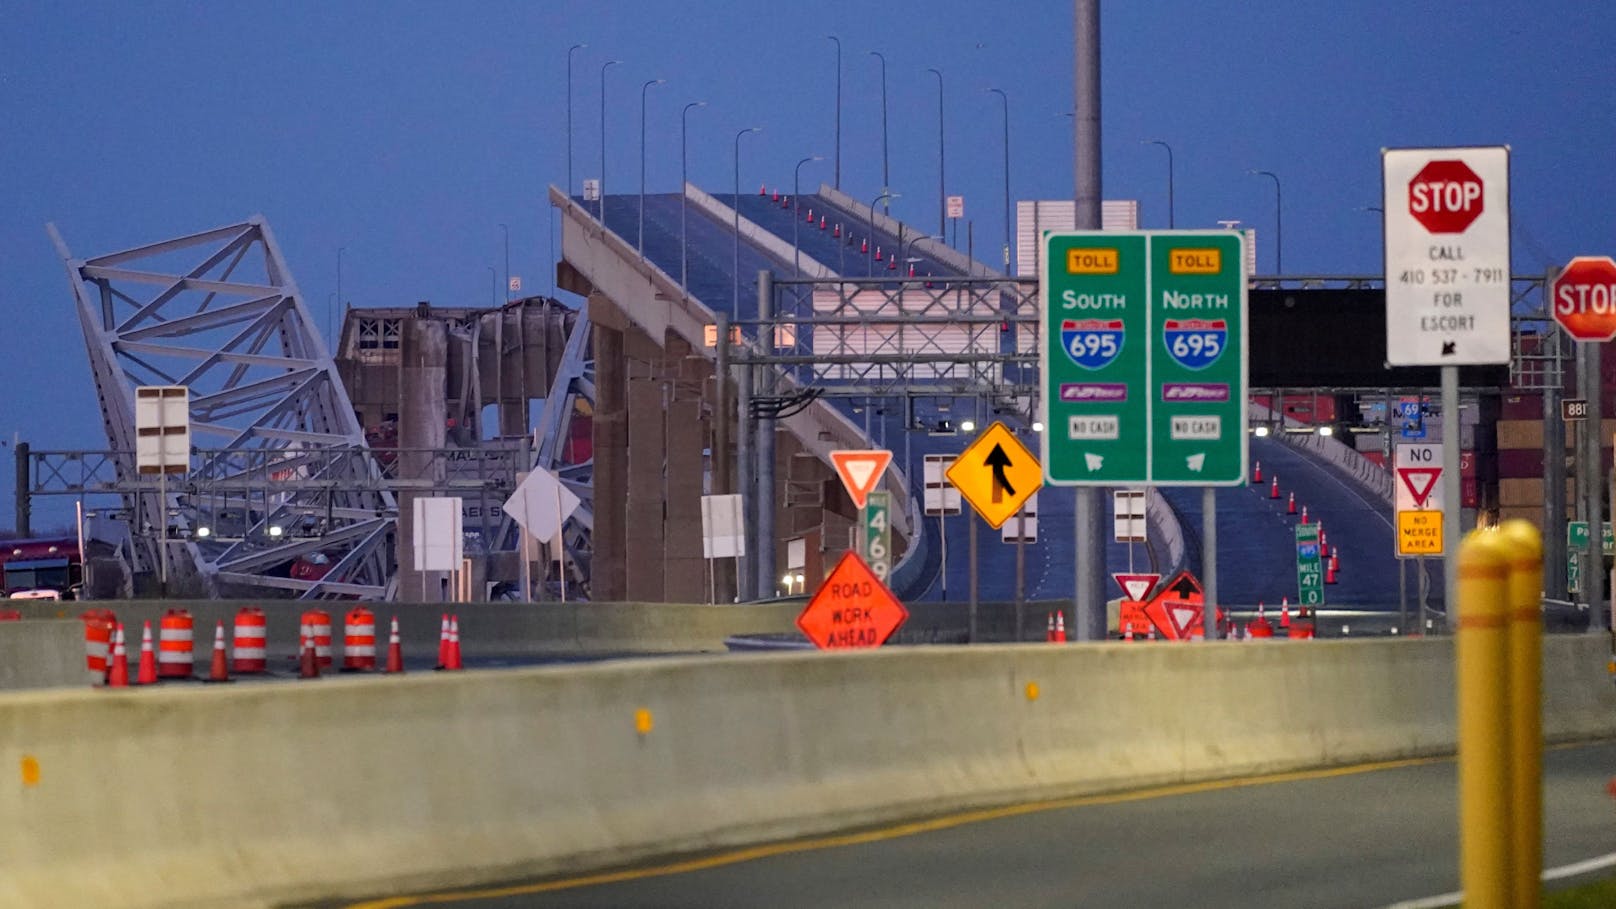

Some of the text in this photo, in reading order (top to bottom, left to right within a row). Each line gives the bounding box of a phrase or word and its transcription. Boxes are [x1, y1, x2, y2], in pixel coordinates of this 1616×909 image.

[1412, 181, 1480, 213] STOP
[1429, 246, 1465, 260] CALL
[1074, 255, 1112, 267] TOLL
[1176, 255, 1214, 267] TOLL
[1399, 270, 1425, 284] 410
[1431, 269, 1458, 283] 537
[1473, 268, 1503, 283] 7911
[1434, 293, 1462, 307] FOR
[1421, 315, 1475, 331] ESCORT
[1070, 334, 1117, 357] 695
[1173, 334, 1220, 357] 695
[1074, 421, 1115, 432] NO CASH
[1175, 421, 1217, 432] NO CASH
[1410, 449, 1432, 462] NO
[1404, 528, 1437, 537] MERGE
[1407, 540, 1435, 548] AREA
[1300, 562, 1319, 573] MILE
[1302, 574, 1318, 587] 47
[832, 582, 872, 598] ROAD
[1308, 591, 1317, 603] 0
[832, 608, 872, 624] WORK
[827, 629, 877, 648] AHEAD
